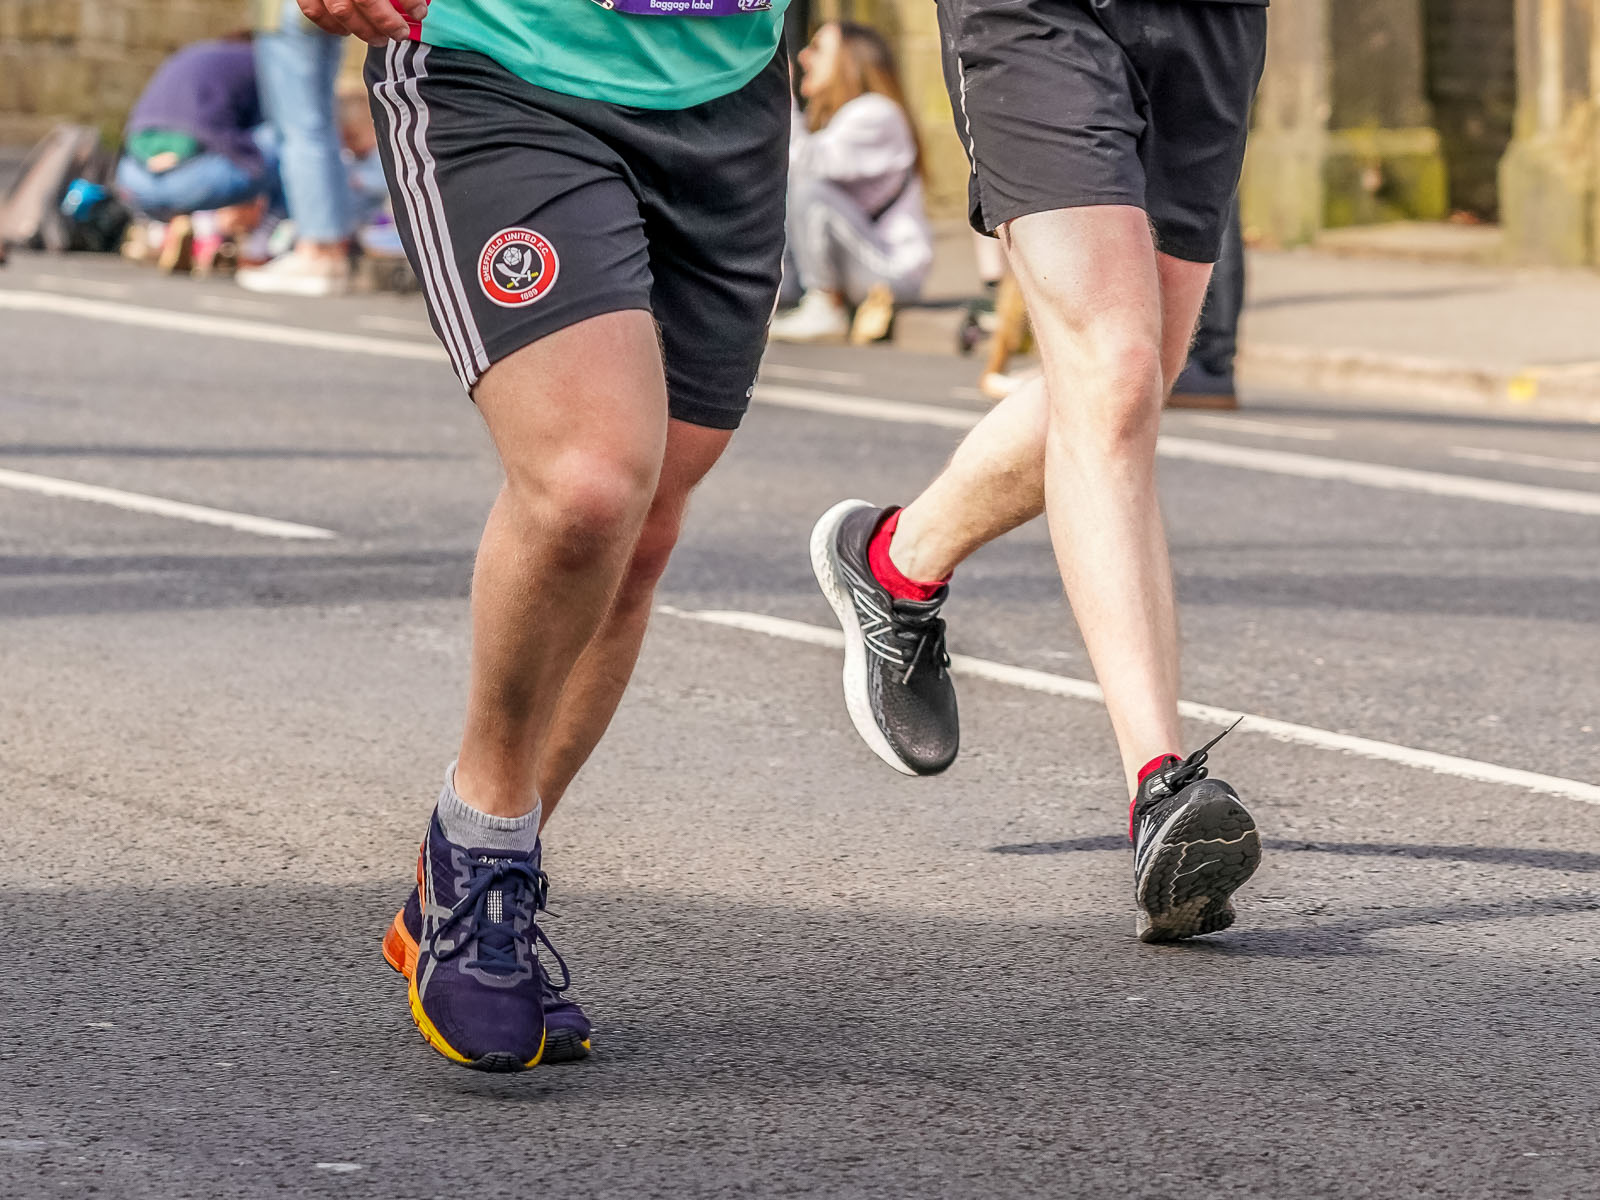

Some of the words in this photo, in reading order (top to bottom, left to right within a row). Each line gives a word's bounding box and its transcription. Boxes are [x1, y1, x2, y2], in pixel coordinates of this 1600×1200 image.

[691, 0, 714, 10] label
[482, 238, 504, 283] SHEFFIELD
[504, 232, 537, 244] UNITED
